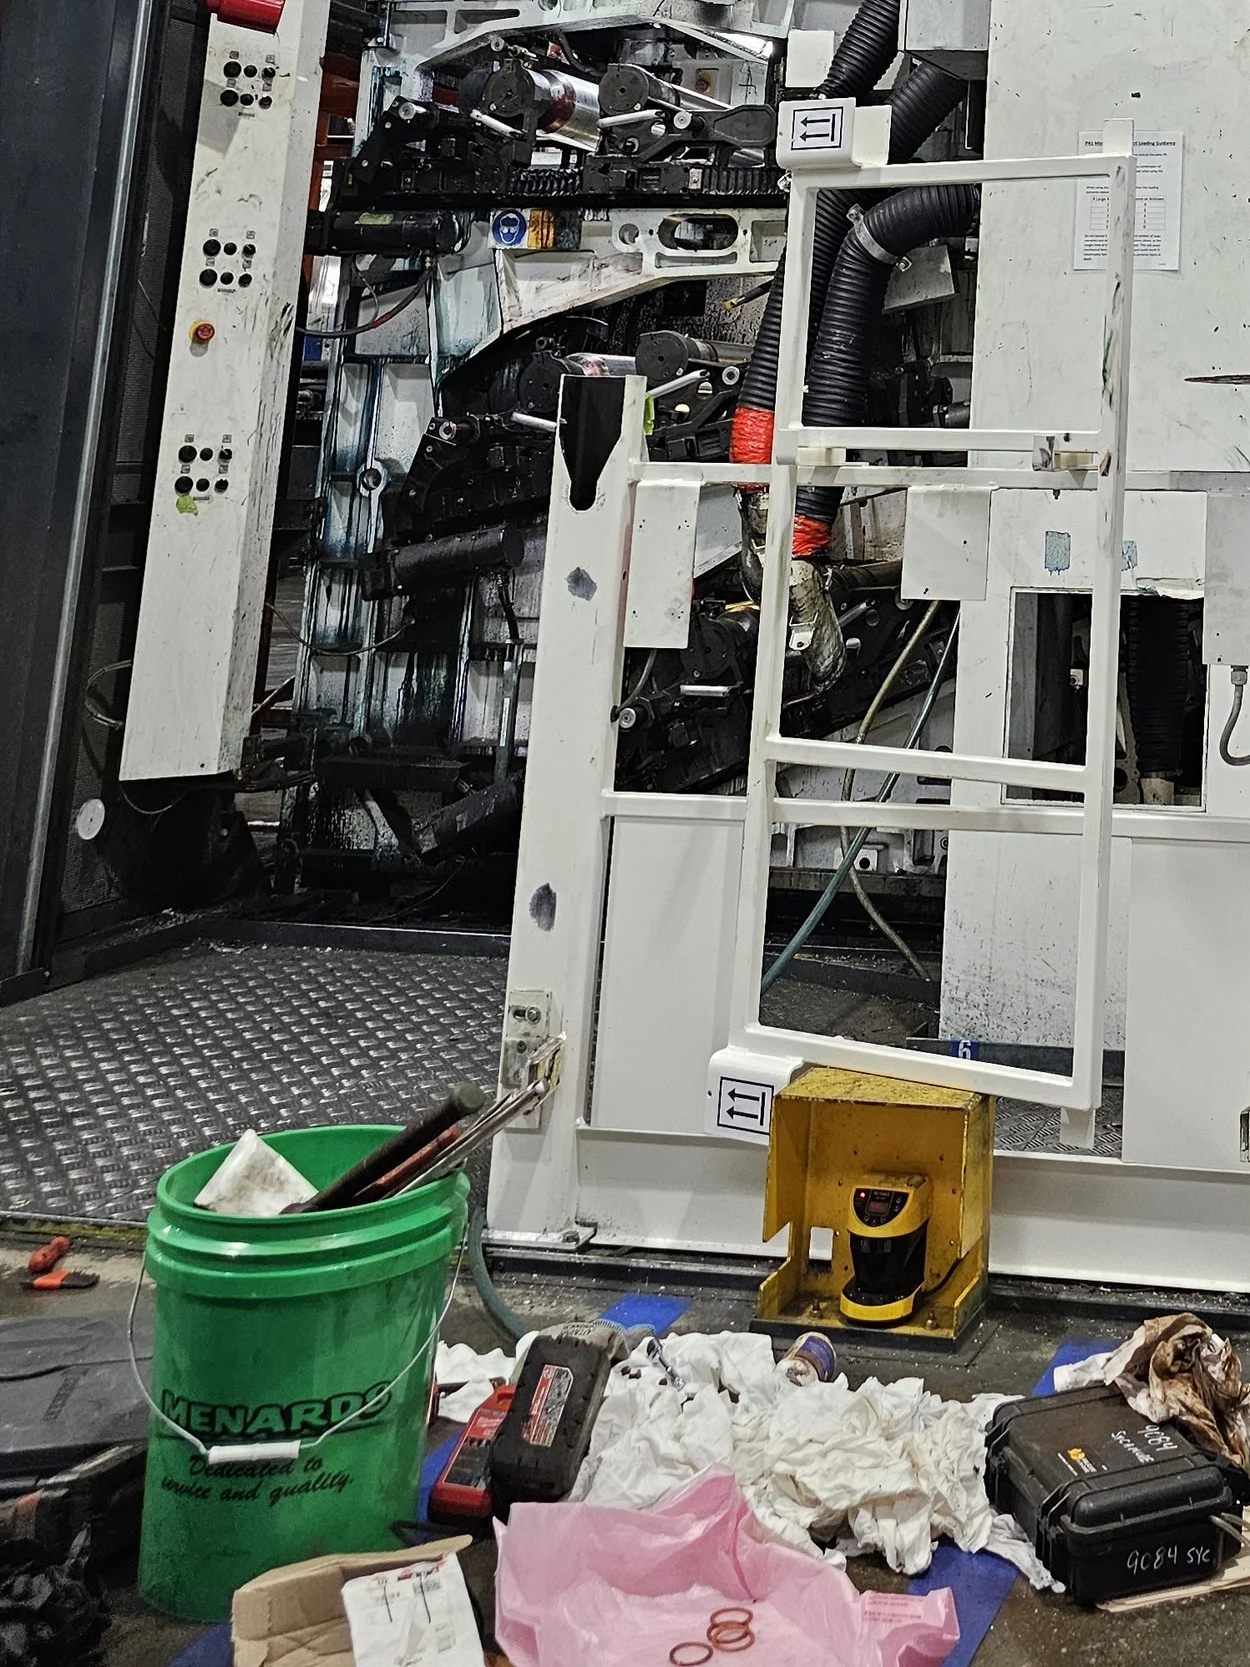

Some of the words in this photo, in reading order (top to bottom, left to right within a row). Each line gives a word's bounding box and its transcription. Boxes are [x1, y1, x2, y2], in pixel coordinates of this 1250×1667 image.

[161, 1380, 394, 1435] MENARDS
[303, 1455, 323, 1473] to
[220, 1479, 264, 1502] and
